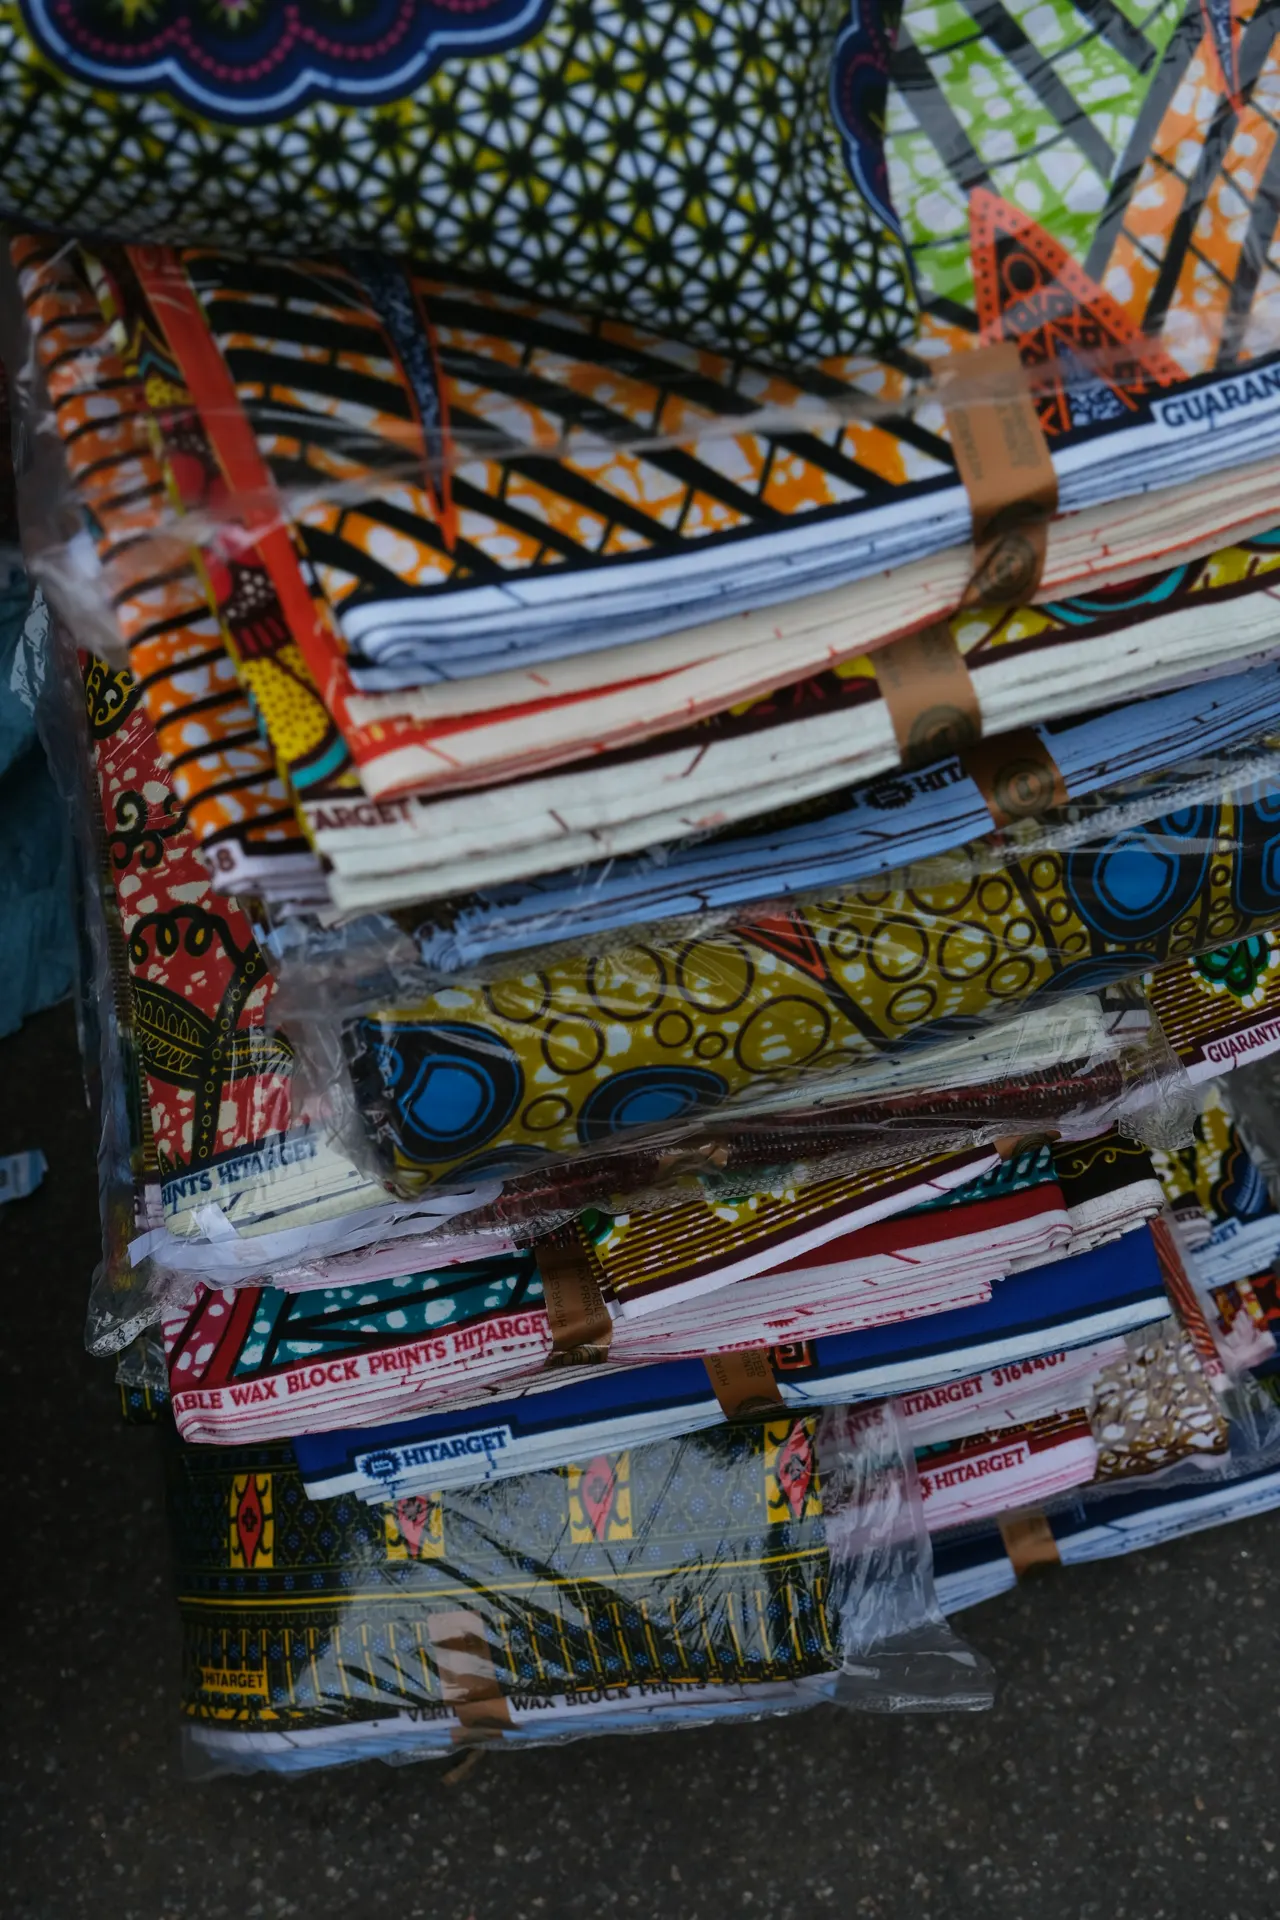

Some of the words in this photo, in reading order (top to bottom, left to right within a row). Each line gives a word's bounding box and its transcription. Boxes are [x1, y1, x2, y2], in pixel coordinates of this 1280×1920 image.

[308, 799, 411, 830] ARGET
[548, 1266, 568, 1329] HITARGE
[581, 1285, 595, 1327] PRINTS
[174, 1391, 222, 1416] ABLE
[229, 1380, 279, 1407] WAX
[286, 1360, 360, 1394] BLOCK
[368, 1340, 447, 1376] PRINTS
[902, 1376, 984, 1416] ITARGET
[402, 1431, 506, 1467] HITARGET
[934, 1448, 1026, 1490] HITARGET
[205, 1672, 263, 1689] HITARGET
[510, 1694, 556, 1712] WAX
